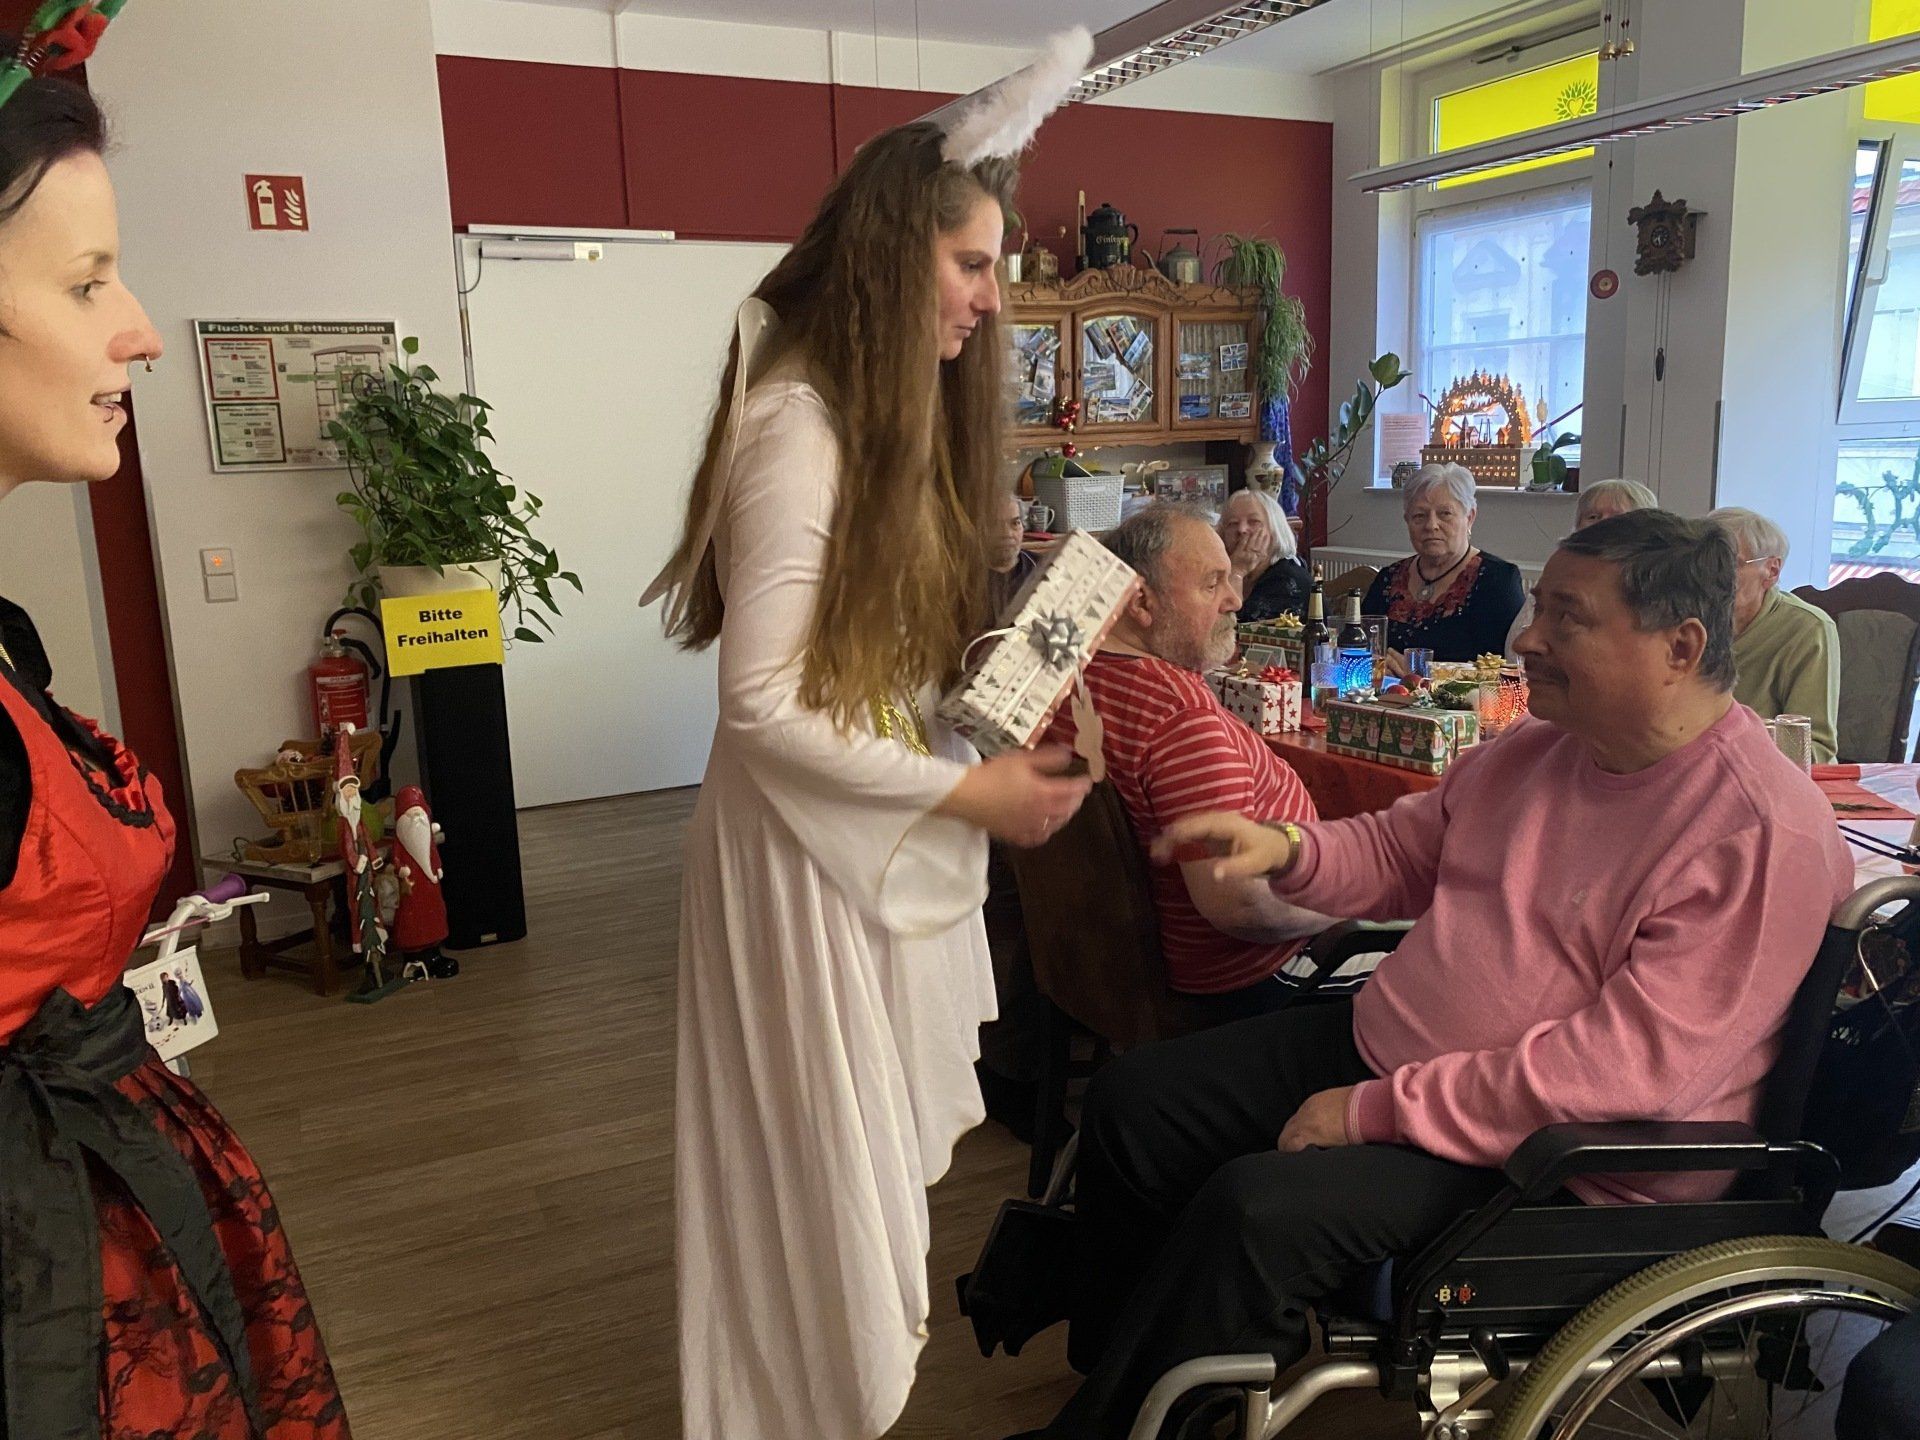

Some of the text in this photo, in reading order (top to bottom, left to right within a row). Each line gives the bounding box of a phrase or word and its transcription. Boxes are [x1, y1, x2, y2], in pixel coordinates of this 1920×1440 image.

[207, 323, 386, 334] Flucht- und Rettungsplan
[418, 608, 463, 623] Bitte
[397, 628, 489, 648] Freihalten
